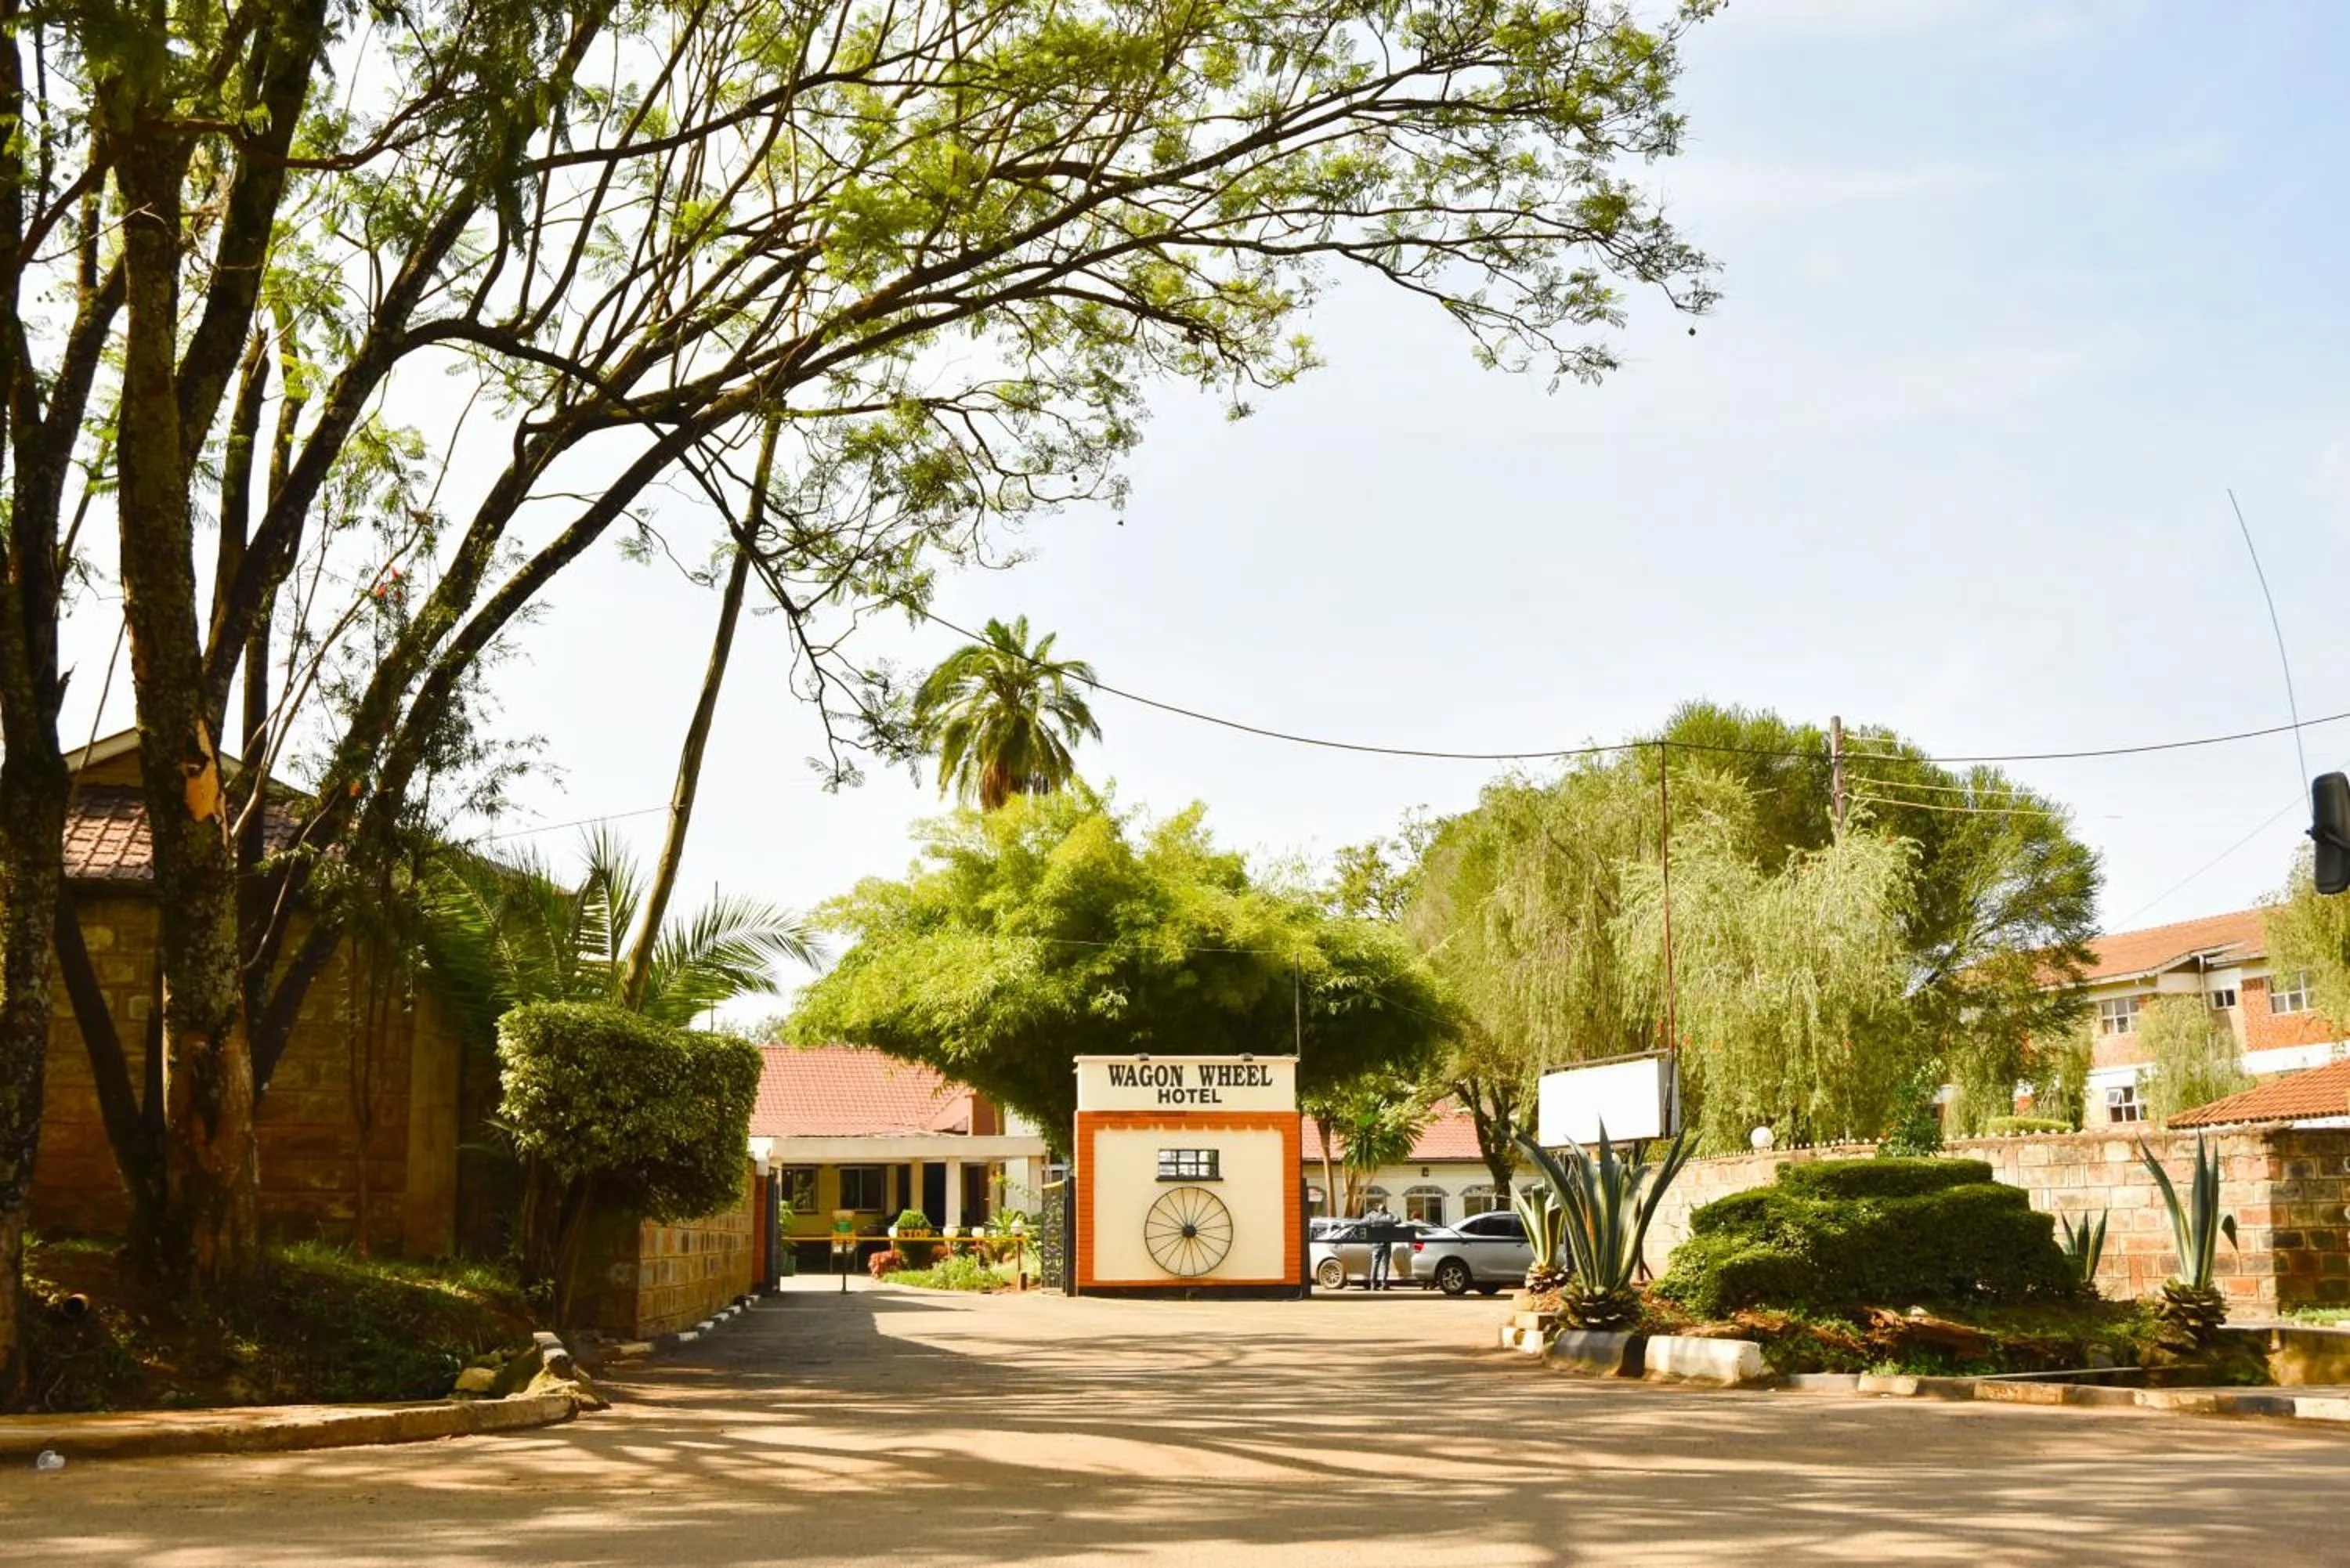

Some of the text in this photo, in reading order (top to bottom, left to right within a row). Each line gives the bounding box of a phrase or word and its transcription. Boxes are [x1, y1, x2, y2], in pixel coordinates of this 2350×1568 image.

[1108, 1064, 1273, 1087] WAGON WHEEL
[1157, 1088, 1223, 1104] HOTEL
